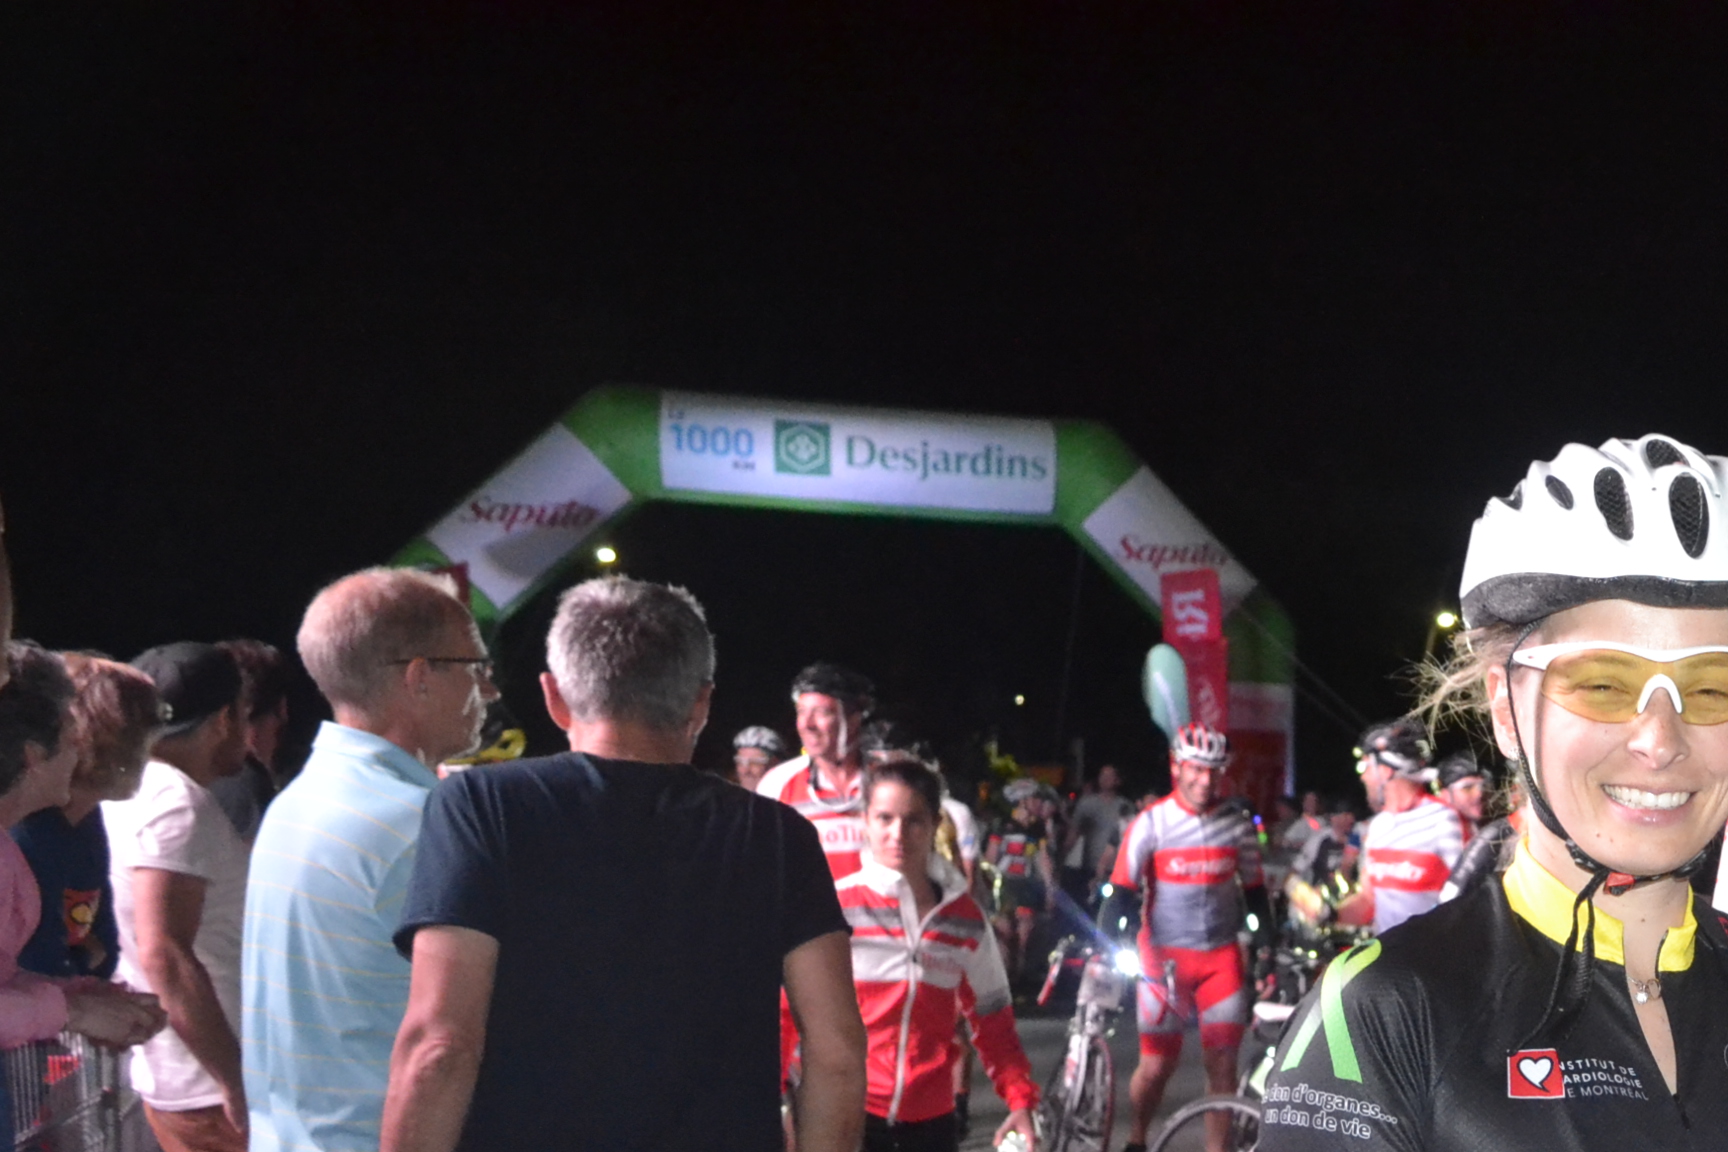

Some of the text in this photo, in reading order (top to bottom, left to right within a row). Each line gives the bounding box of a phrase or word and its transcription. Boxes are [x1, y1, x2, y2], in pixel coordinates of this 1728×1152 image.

[669, 422, 755, 458] 1000
[845, 434, 1048, 480] Desjardins
[467, 499, 598, 533] Saputo
[1120, 536, 1228, 571] Saputo
[1559, 1058, 1637, 1077] NSTITUT DE
[1563, 1071, 1643, 1089] ARDIOLOGIE
[1580, 1084, 1650, 1101] MONTRÉAL
[1279, 1104, 1310, 1127] don
[1312, 1110, 1338, 1132] de
[1341, 1117, 1372, 1140] vie
